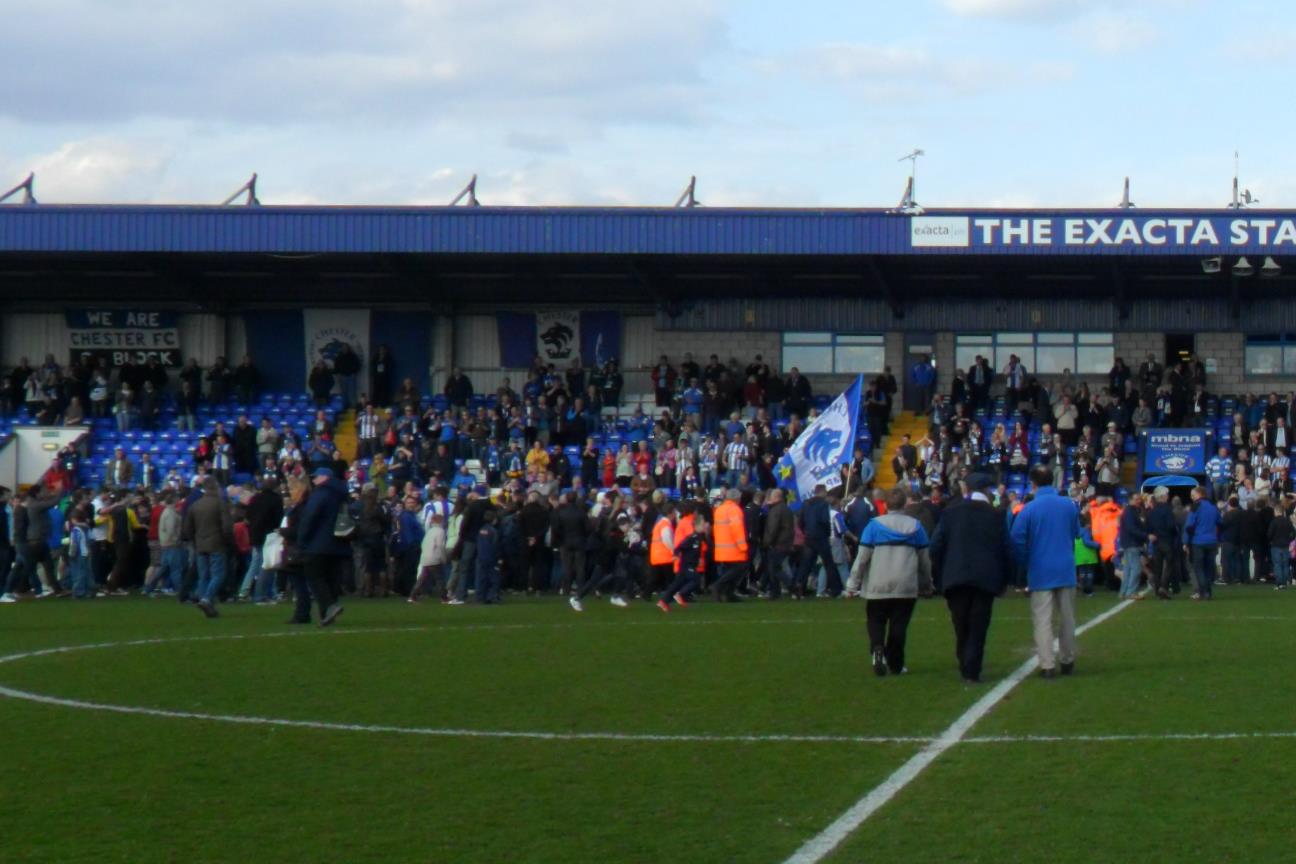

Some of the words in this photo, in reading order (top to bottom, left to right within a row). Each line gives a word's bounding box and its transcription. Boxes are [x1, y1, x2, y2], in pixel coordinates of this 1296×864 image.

[914, 224, 949, 235] exacta
[975, 219, 1052, 245] THE
[1065, 219, 1219, 245] EXACTA
[87, 312, 112, 326] WE
[126, 312, 160, 327] ARE
[70, 332, 146, 346] CHESTER
[153, 332, 175, 346] FC
[1151, 434, 1201, 443] mbna
